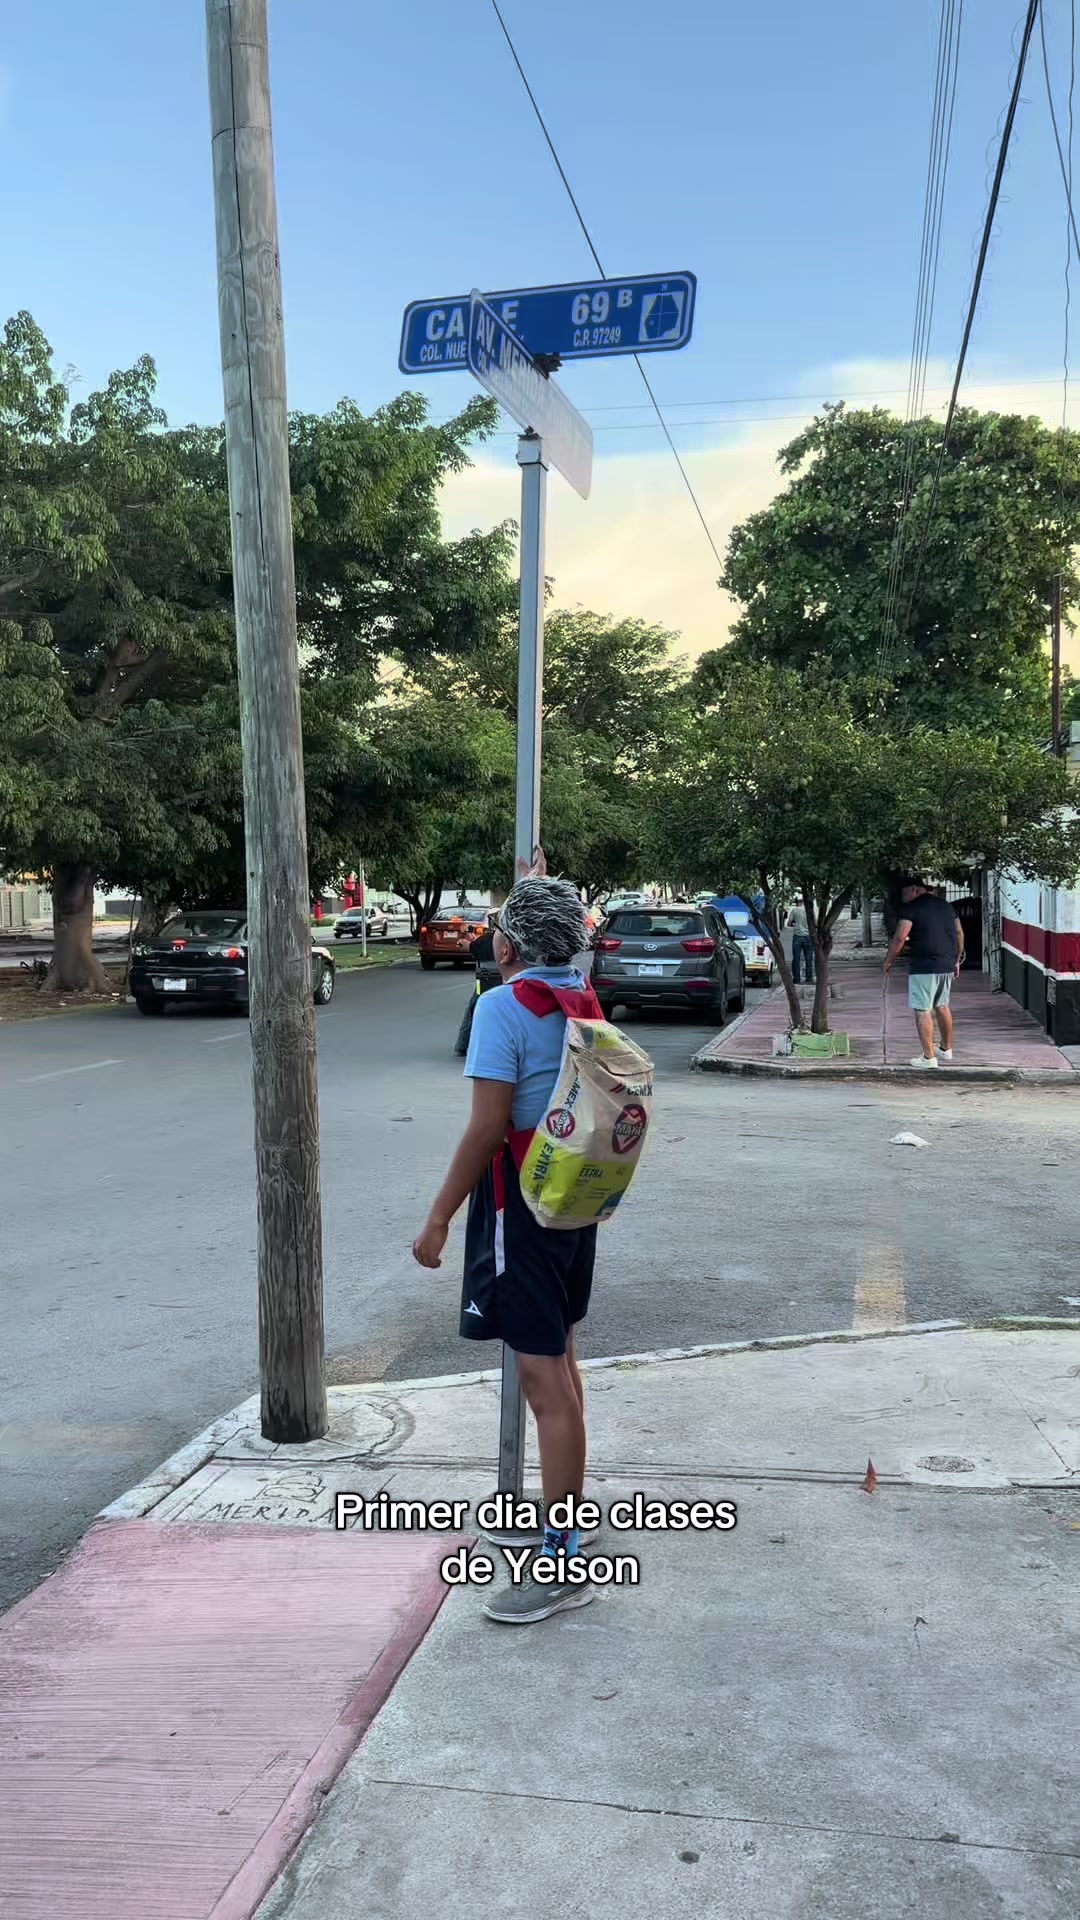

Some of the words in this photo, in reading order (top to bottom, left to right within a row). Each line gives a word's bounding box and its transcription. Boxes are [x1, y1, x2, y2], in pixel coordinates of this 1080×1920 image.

[571, 290, 610, 326] 69
[616, 288, 633, 308] B
[475, 307, 496, 358] AV.
[592, 325, 621, 346] 97249
[420, 343, 443, 362] COL.
[532, 1141, 554, 1180] EXTRA
